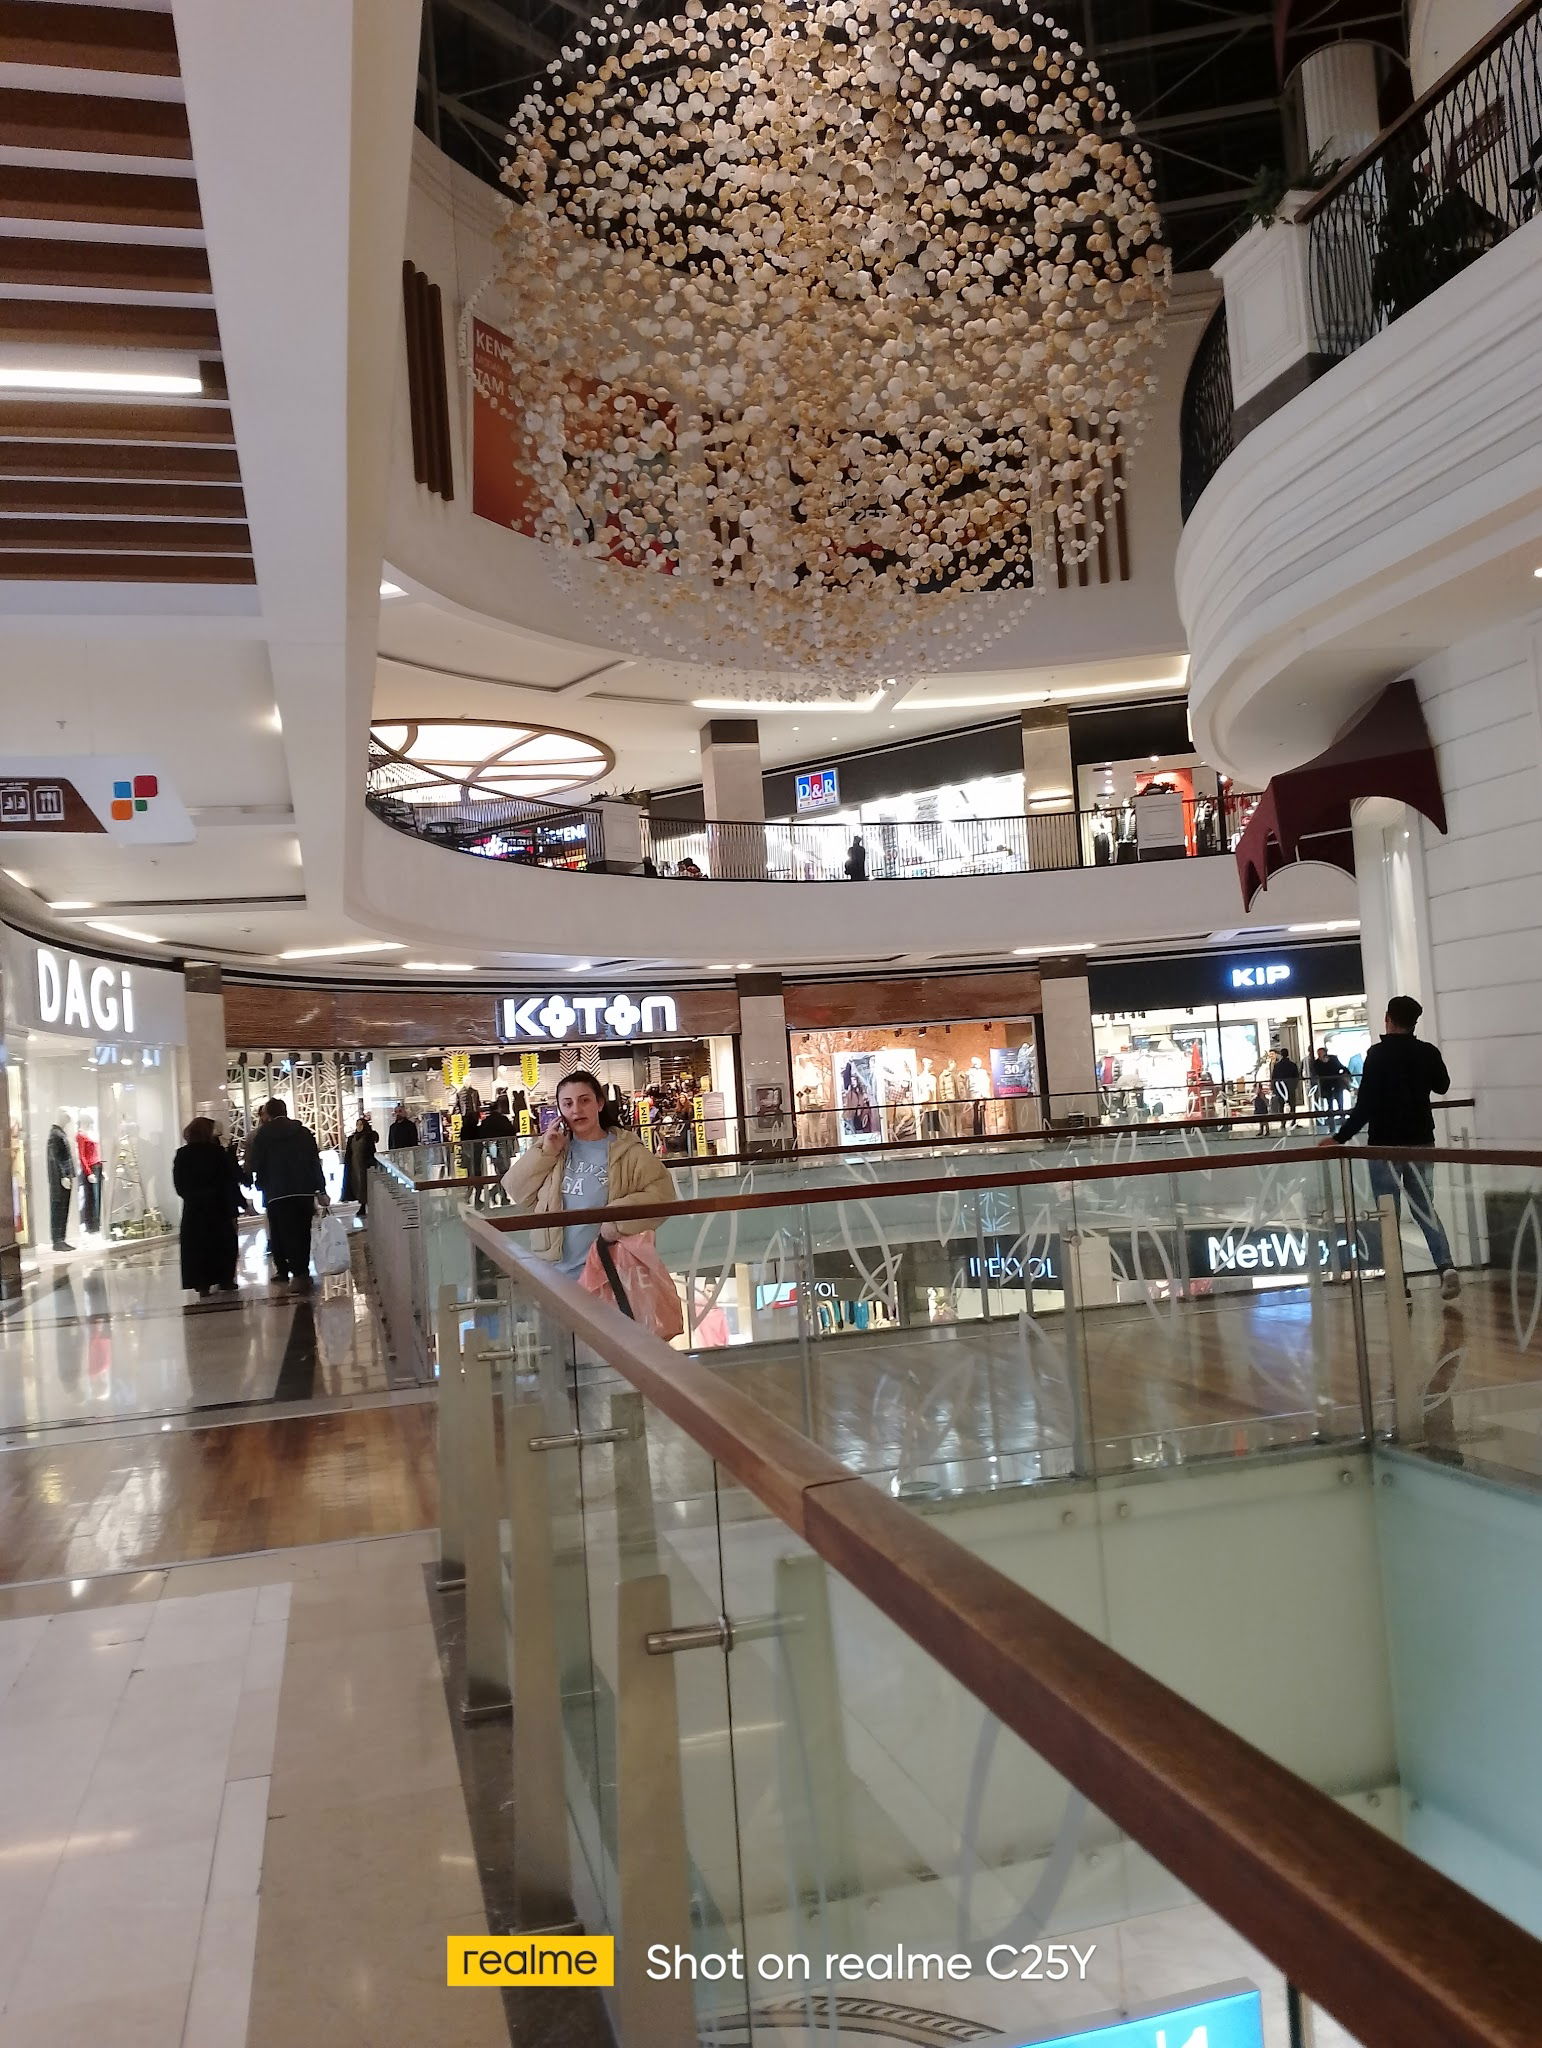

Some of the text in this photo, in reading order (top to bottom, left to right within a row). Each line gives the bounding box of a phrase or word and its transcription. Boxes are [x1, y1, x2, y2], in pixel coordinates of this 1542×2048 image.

[799, 779, 835, 798] D&R
[1232, 965, 1290, 987] KIP
[1004, 1064, 1020, 1074] 30
[562, 1176, 584, 1196] GA
